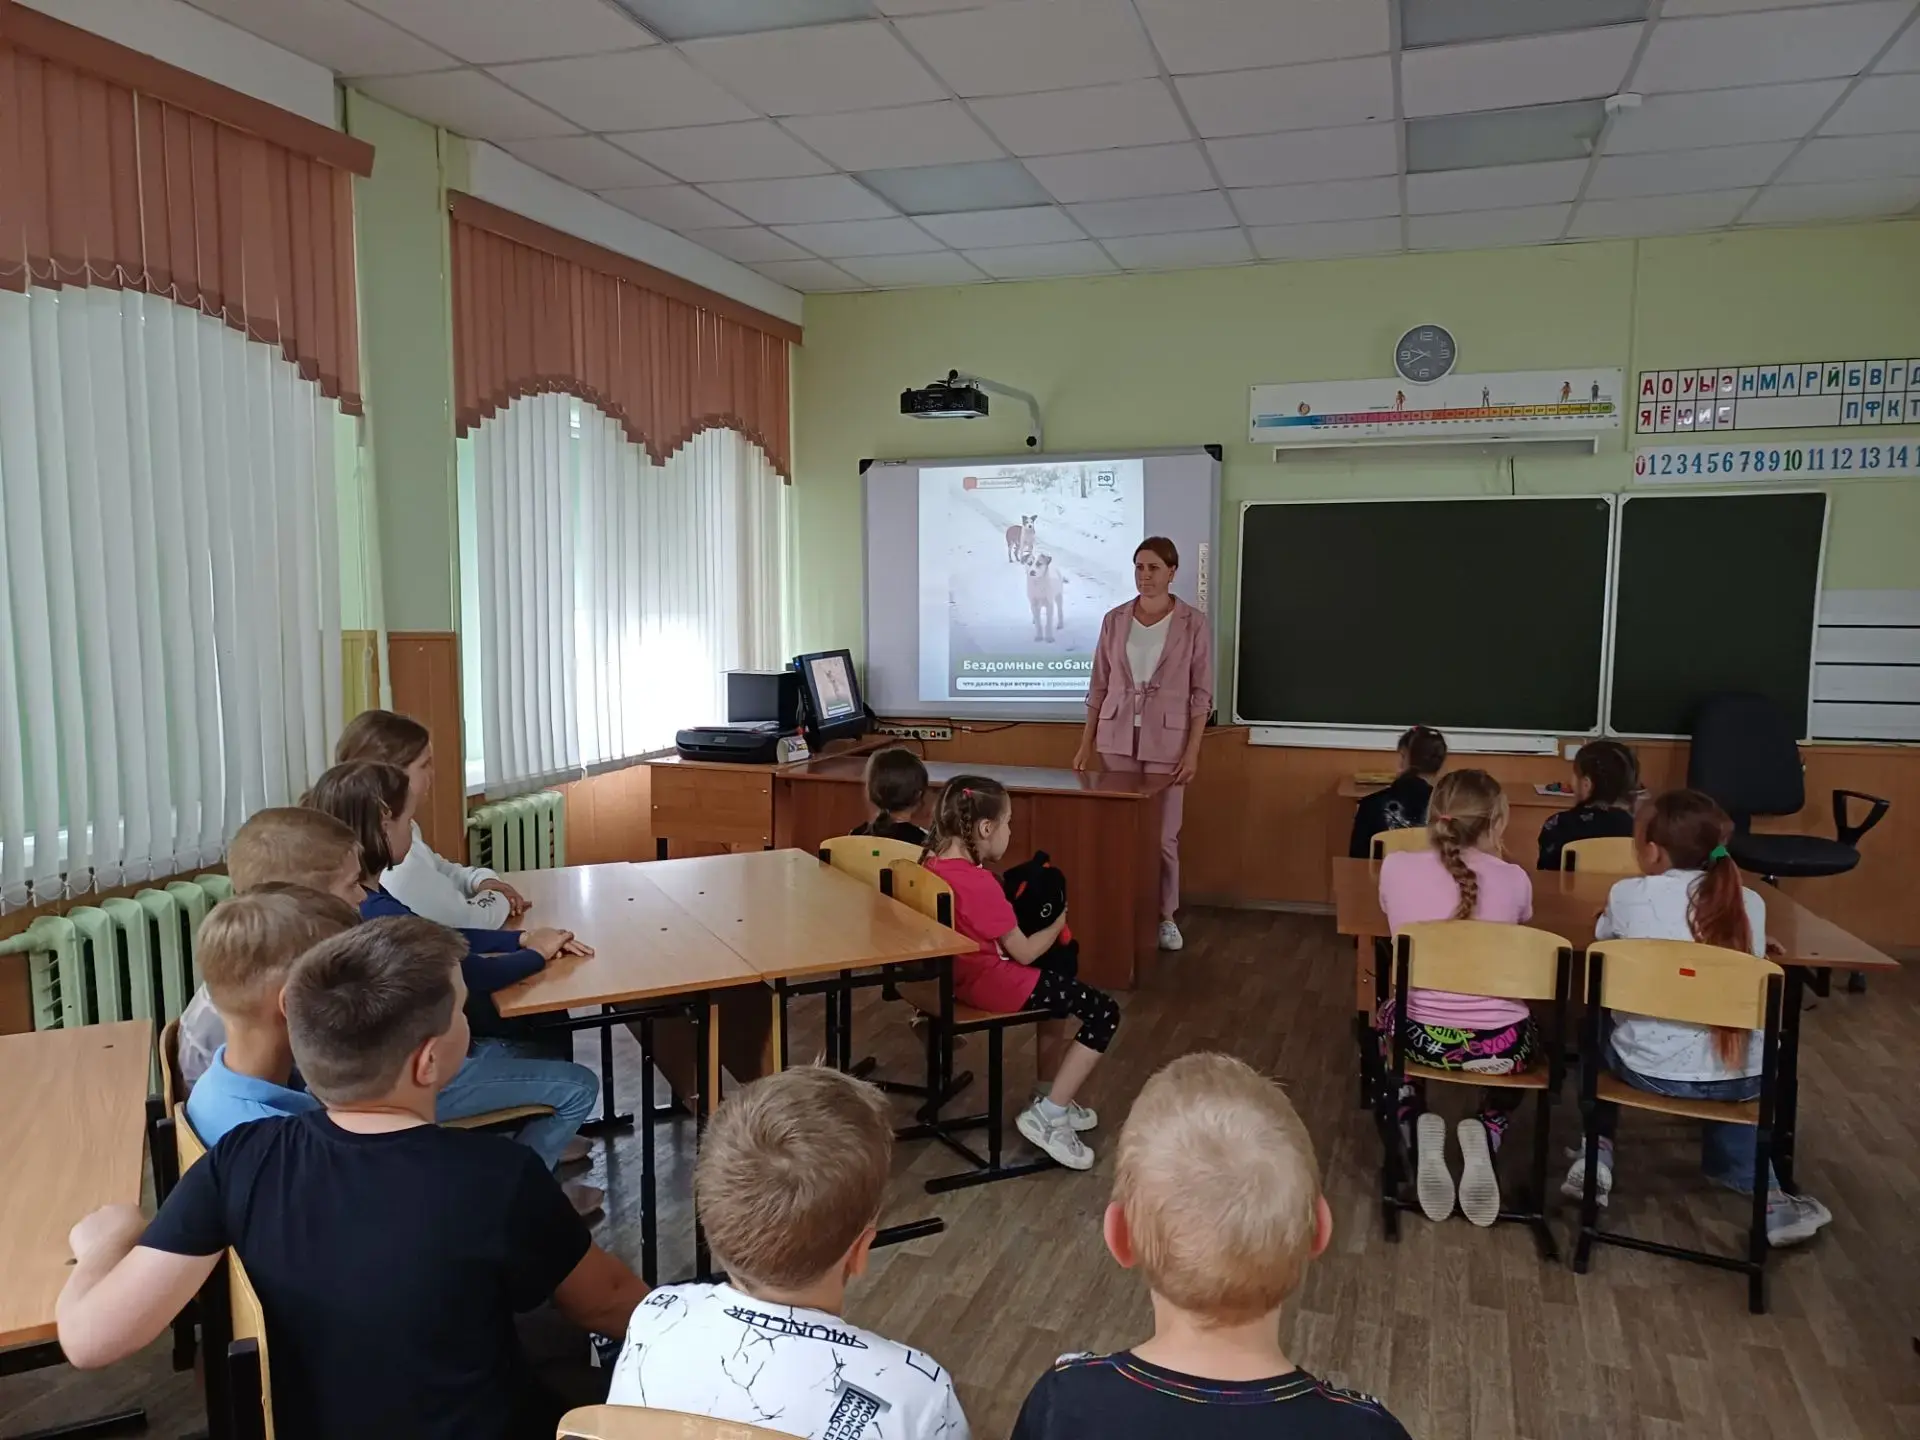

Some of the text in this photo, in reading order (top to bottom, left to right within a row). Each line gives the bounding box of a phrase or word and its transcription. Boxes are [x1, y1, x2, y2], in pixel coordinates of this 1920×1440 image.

[1642, 379, 1654, 395] А
[1661, 377, 1673, 394] О
[1683, 376, 1694, 393] У
[1699, 376, 1715, 392] Ы
[1742, 374, 1754, 391] Н
[1760, 373, 1777, 390] М
[1782, 372, 1795, 389] Л
[1805, 371, 1818, 388] Р
[1827, 366, 1840, 387] Й
[1848, 369, 1861, 387] Б
[1870, 368, 1882, 385] В
[1891, 367, 1903, 385] Г
[1635, 455, 1646, 476] 0
[1648, 454, 1657, 475] 1
[1661, 454, 1672, 475] 2
[1676, 454, 1688, 474] 3
[1691, 452, 1702, 474] 4
[1707, 452, 1719, 473] 5
[1722, 451, 1734, 472] 6
[1739, 450, 1751, 473] 7
[1753, 450, 1765, 472] 8
[1768, 450, 1780, 472] 9
[1783, 449, 1803, 471] 10
[1807, 448, 1825, 471] 11
[1831, 447, 1853, 470] 12
[1859, 446, 1881, 469] 13
[1886, 445, 1908, 468] 14
[963, 660, 1044, 672] Бездомные
